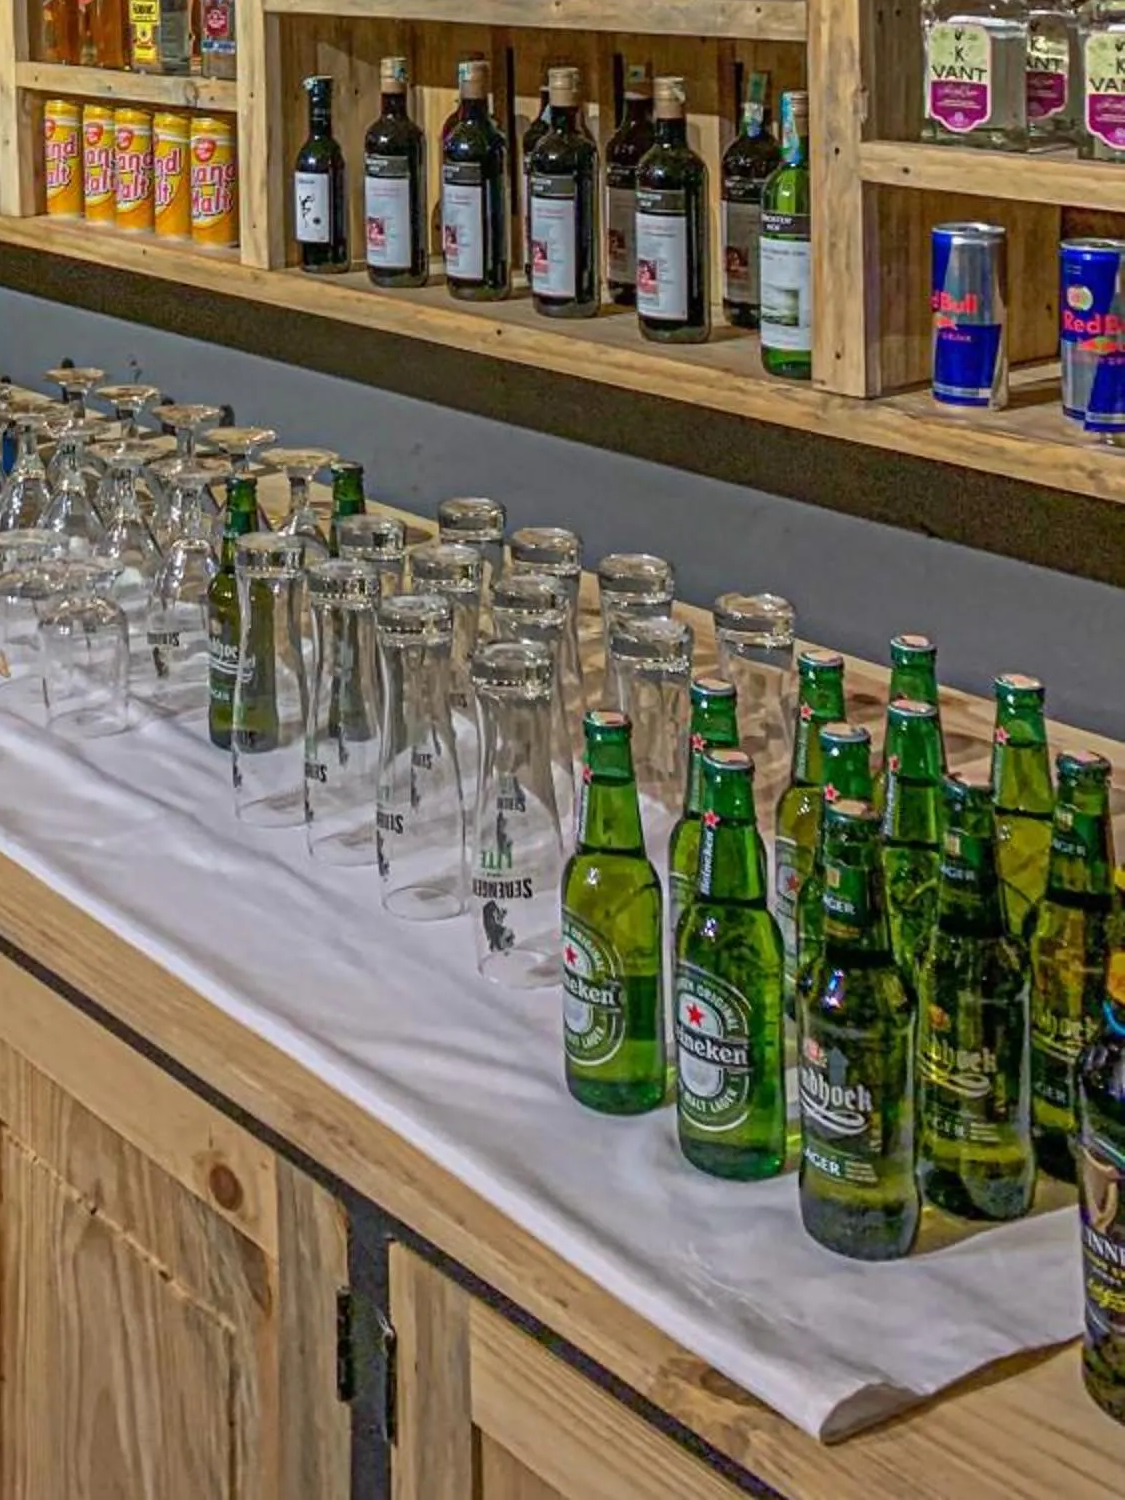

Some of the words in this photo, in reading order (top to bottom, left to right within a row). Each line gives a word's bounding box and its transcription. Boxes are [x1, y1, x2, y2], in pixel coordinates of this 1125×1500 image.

[954, 46, 965, 62] K
[932, 64, 987, 81] VANT
[1026, 57, 1063, 72] ANT
[1062, 309, 1101, 335] Red
